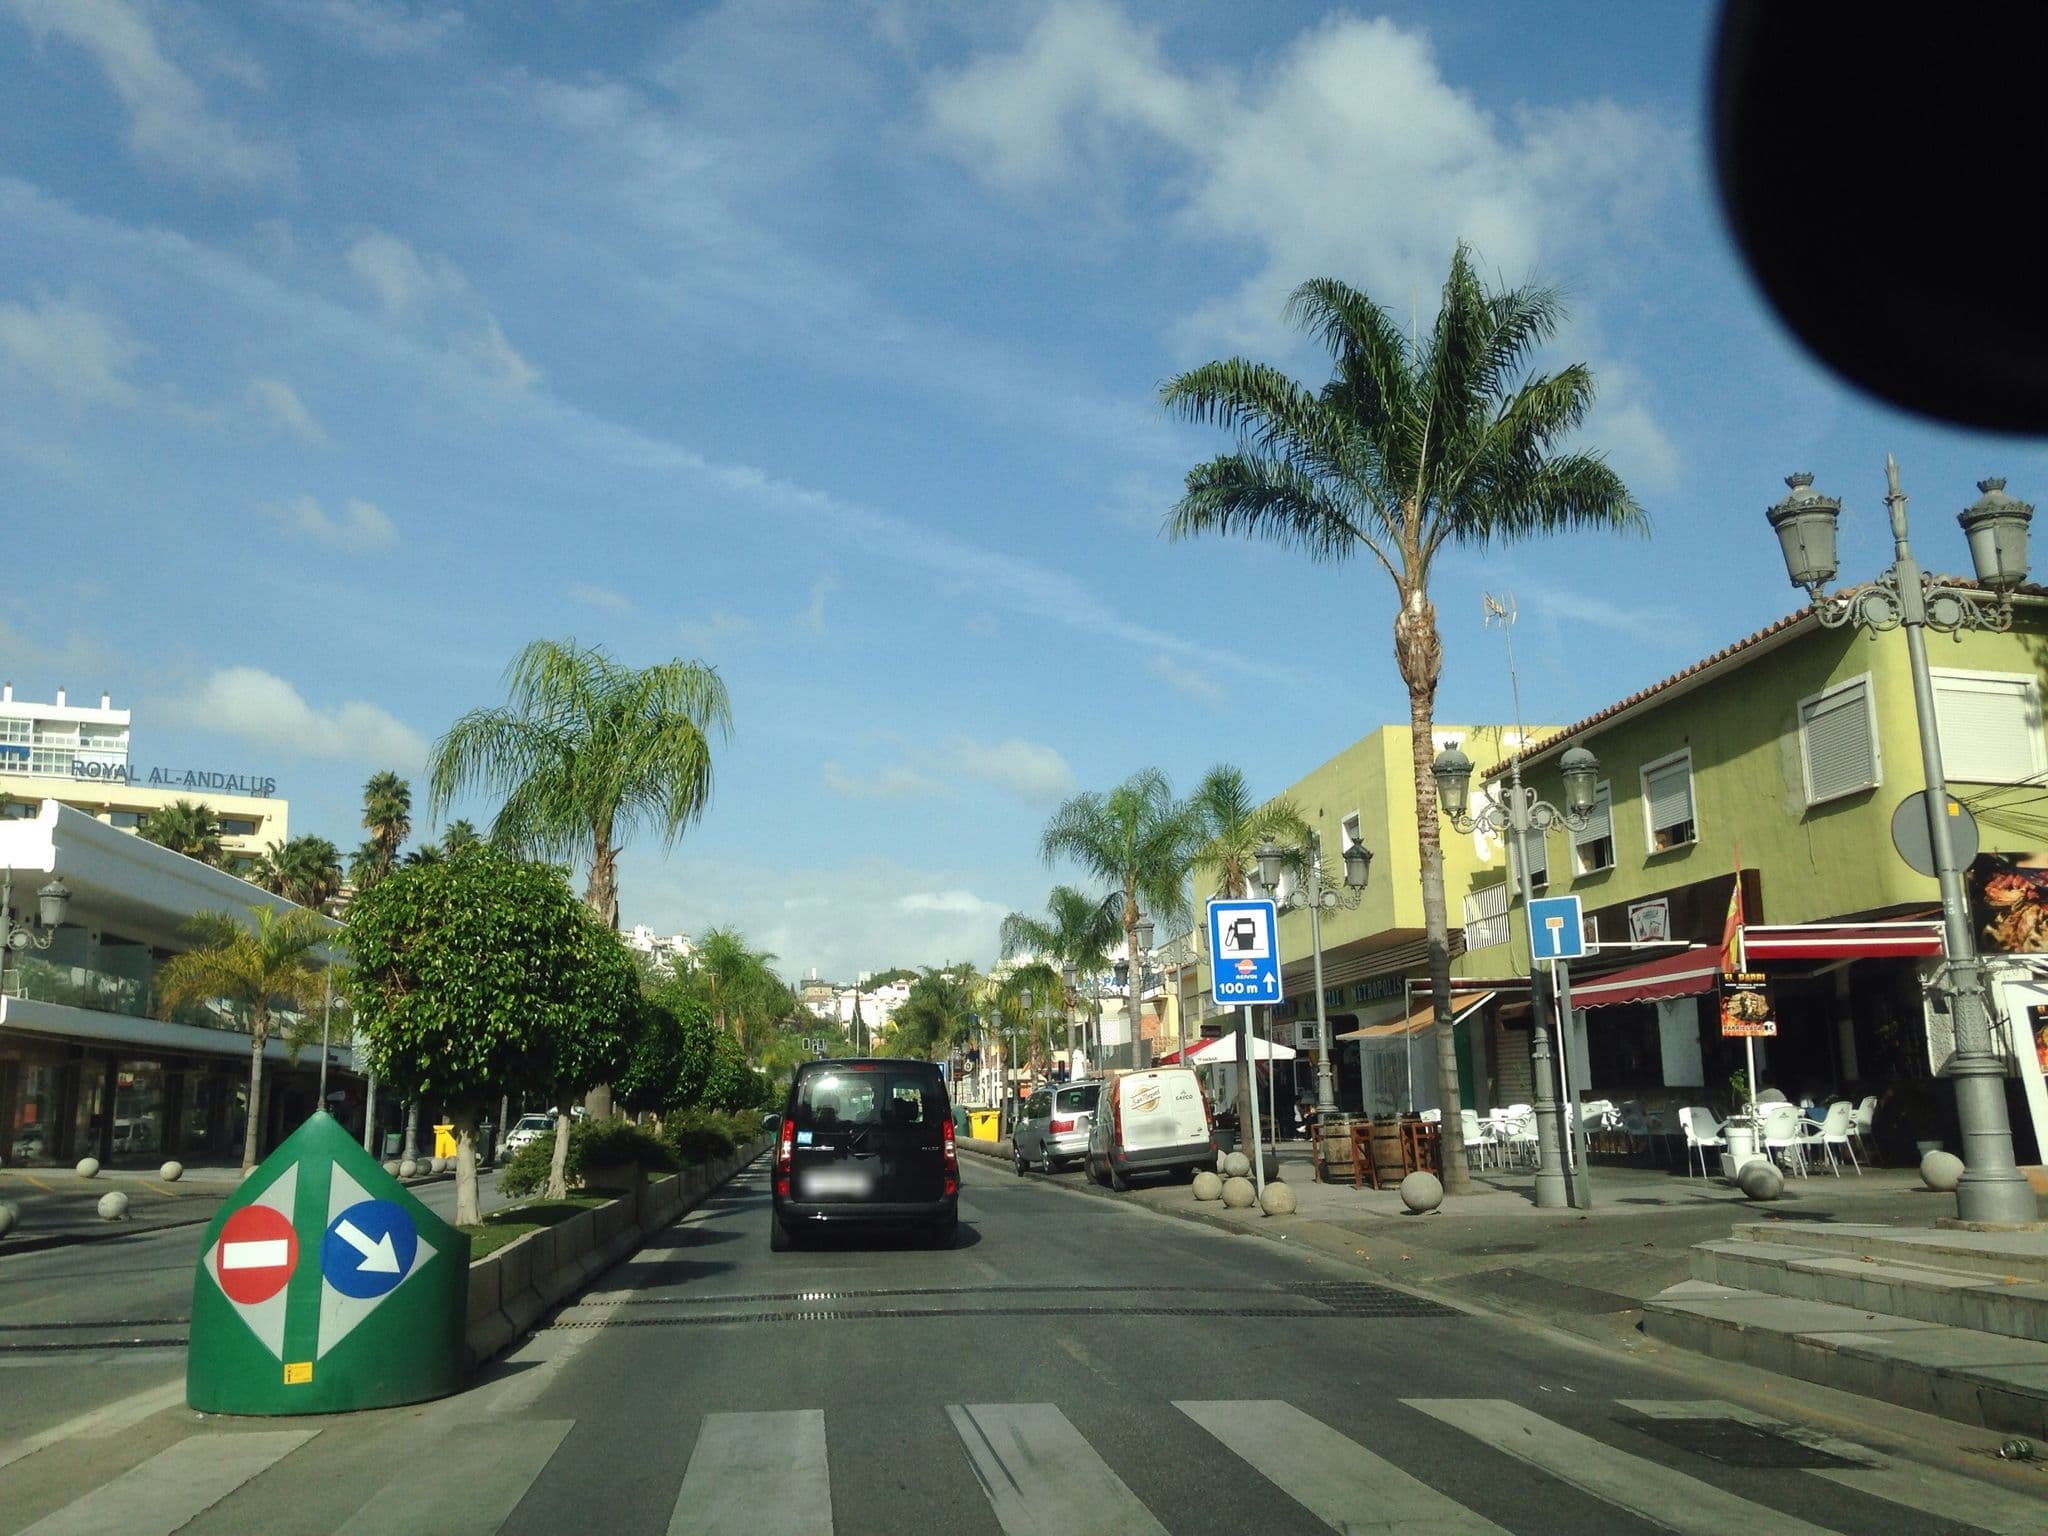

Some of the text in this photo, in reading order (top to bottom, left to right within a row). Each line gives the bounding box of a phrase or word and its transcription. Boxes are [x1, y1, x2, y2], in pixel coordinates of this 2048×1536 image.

[71, 760, 276, 794] ROYAL AL-ANDALUS
[1219, 982, 1258, 995] 100 m
